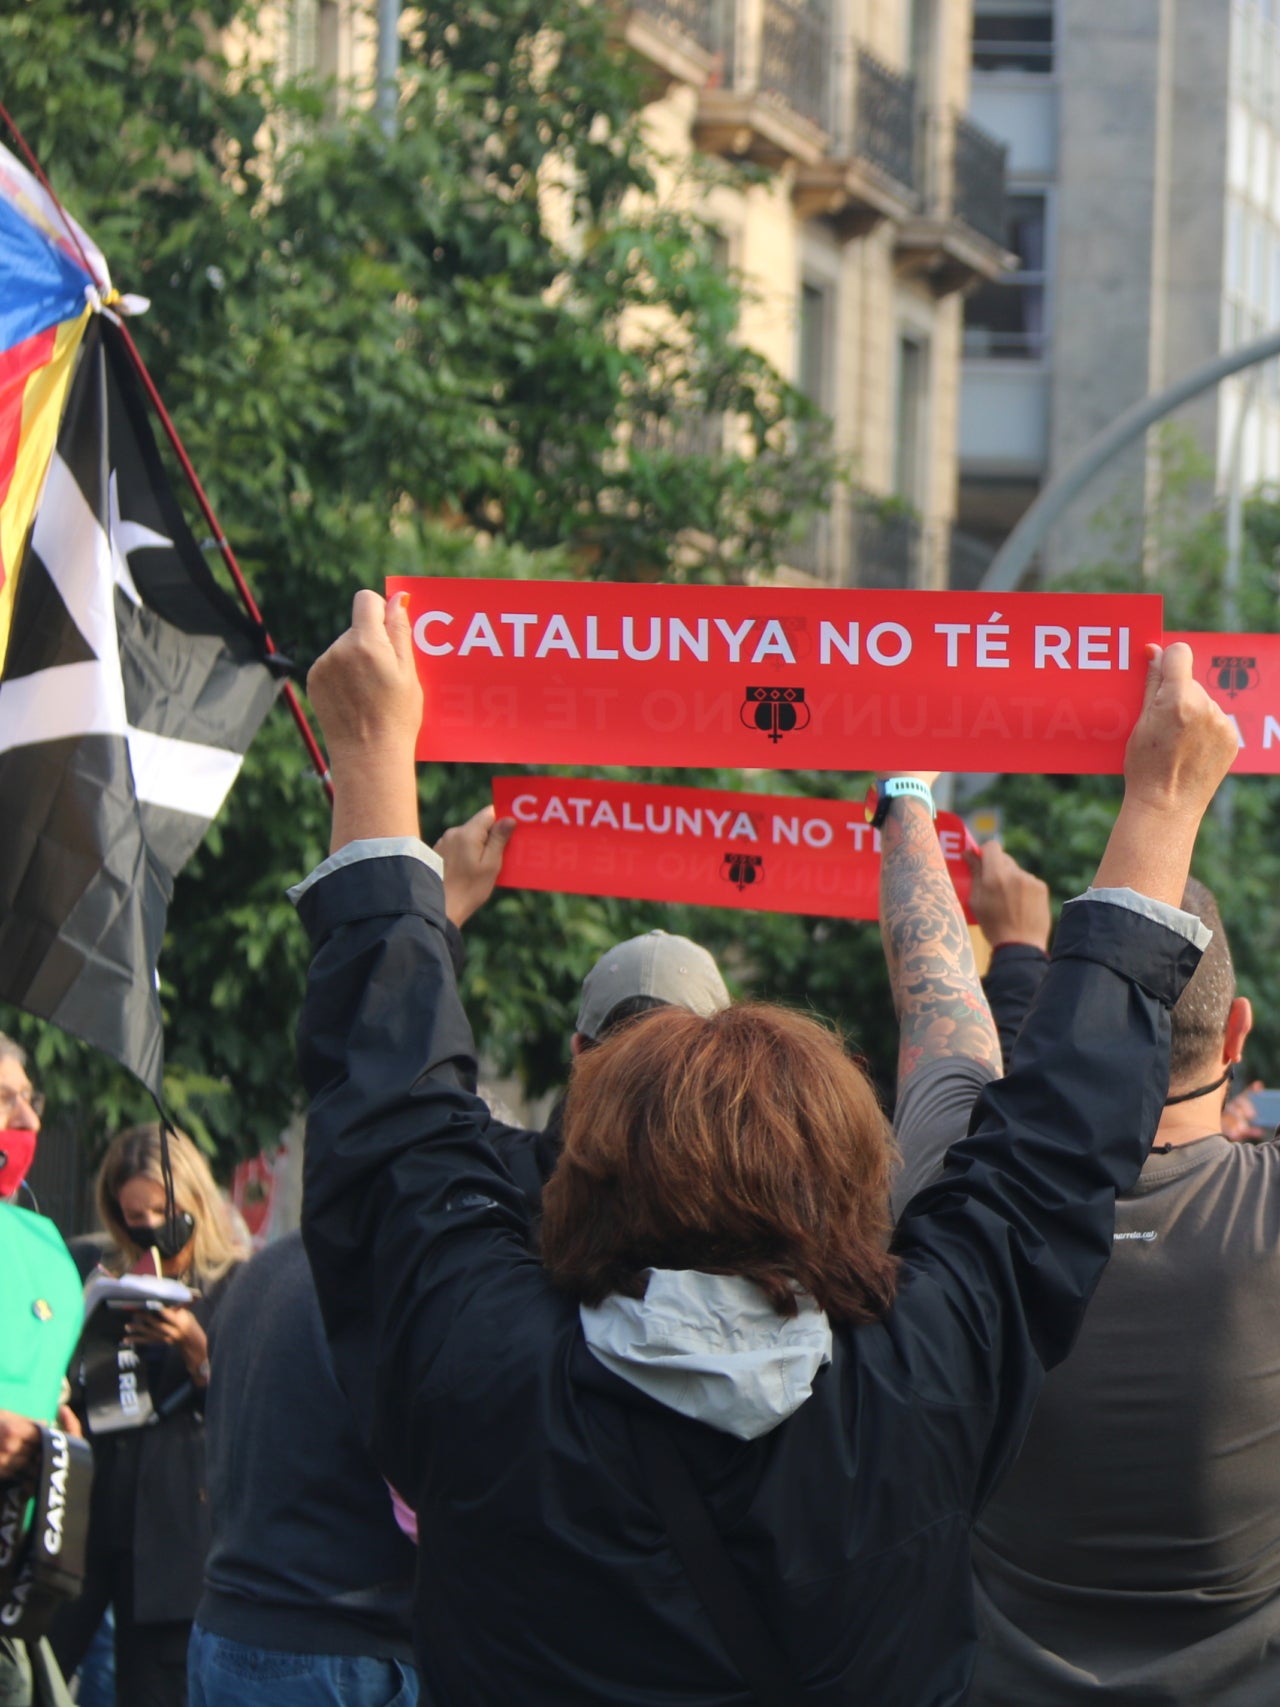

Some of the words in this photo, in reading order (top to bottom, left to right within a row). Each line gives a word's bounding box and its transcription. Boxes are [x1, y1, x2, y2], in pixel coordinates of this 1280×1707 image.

[413, 611, 796, 664] CATALUNYA
[820, 620, 912, 667] NO
[934, 611, 1010, 668] TÉ
[1034, 625, 1130, 670] REI
[511, 794, 758, 842] CATALUNYA
[773, 815, 834, 848] NO
[119, 1372, 140, 1416] REI
